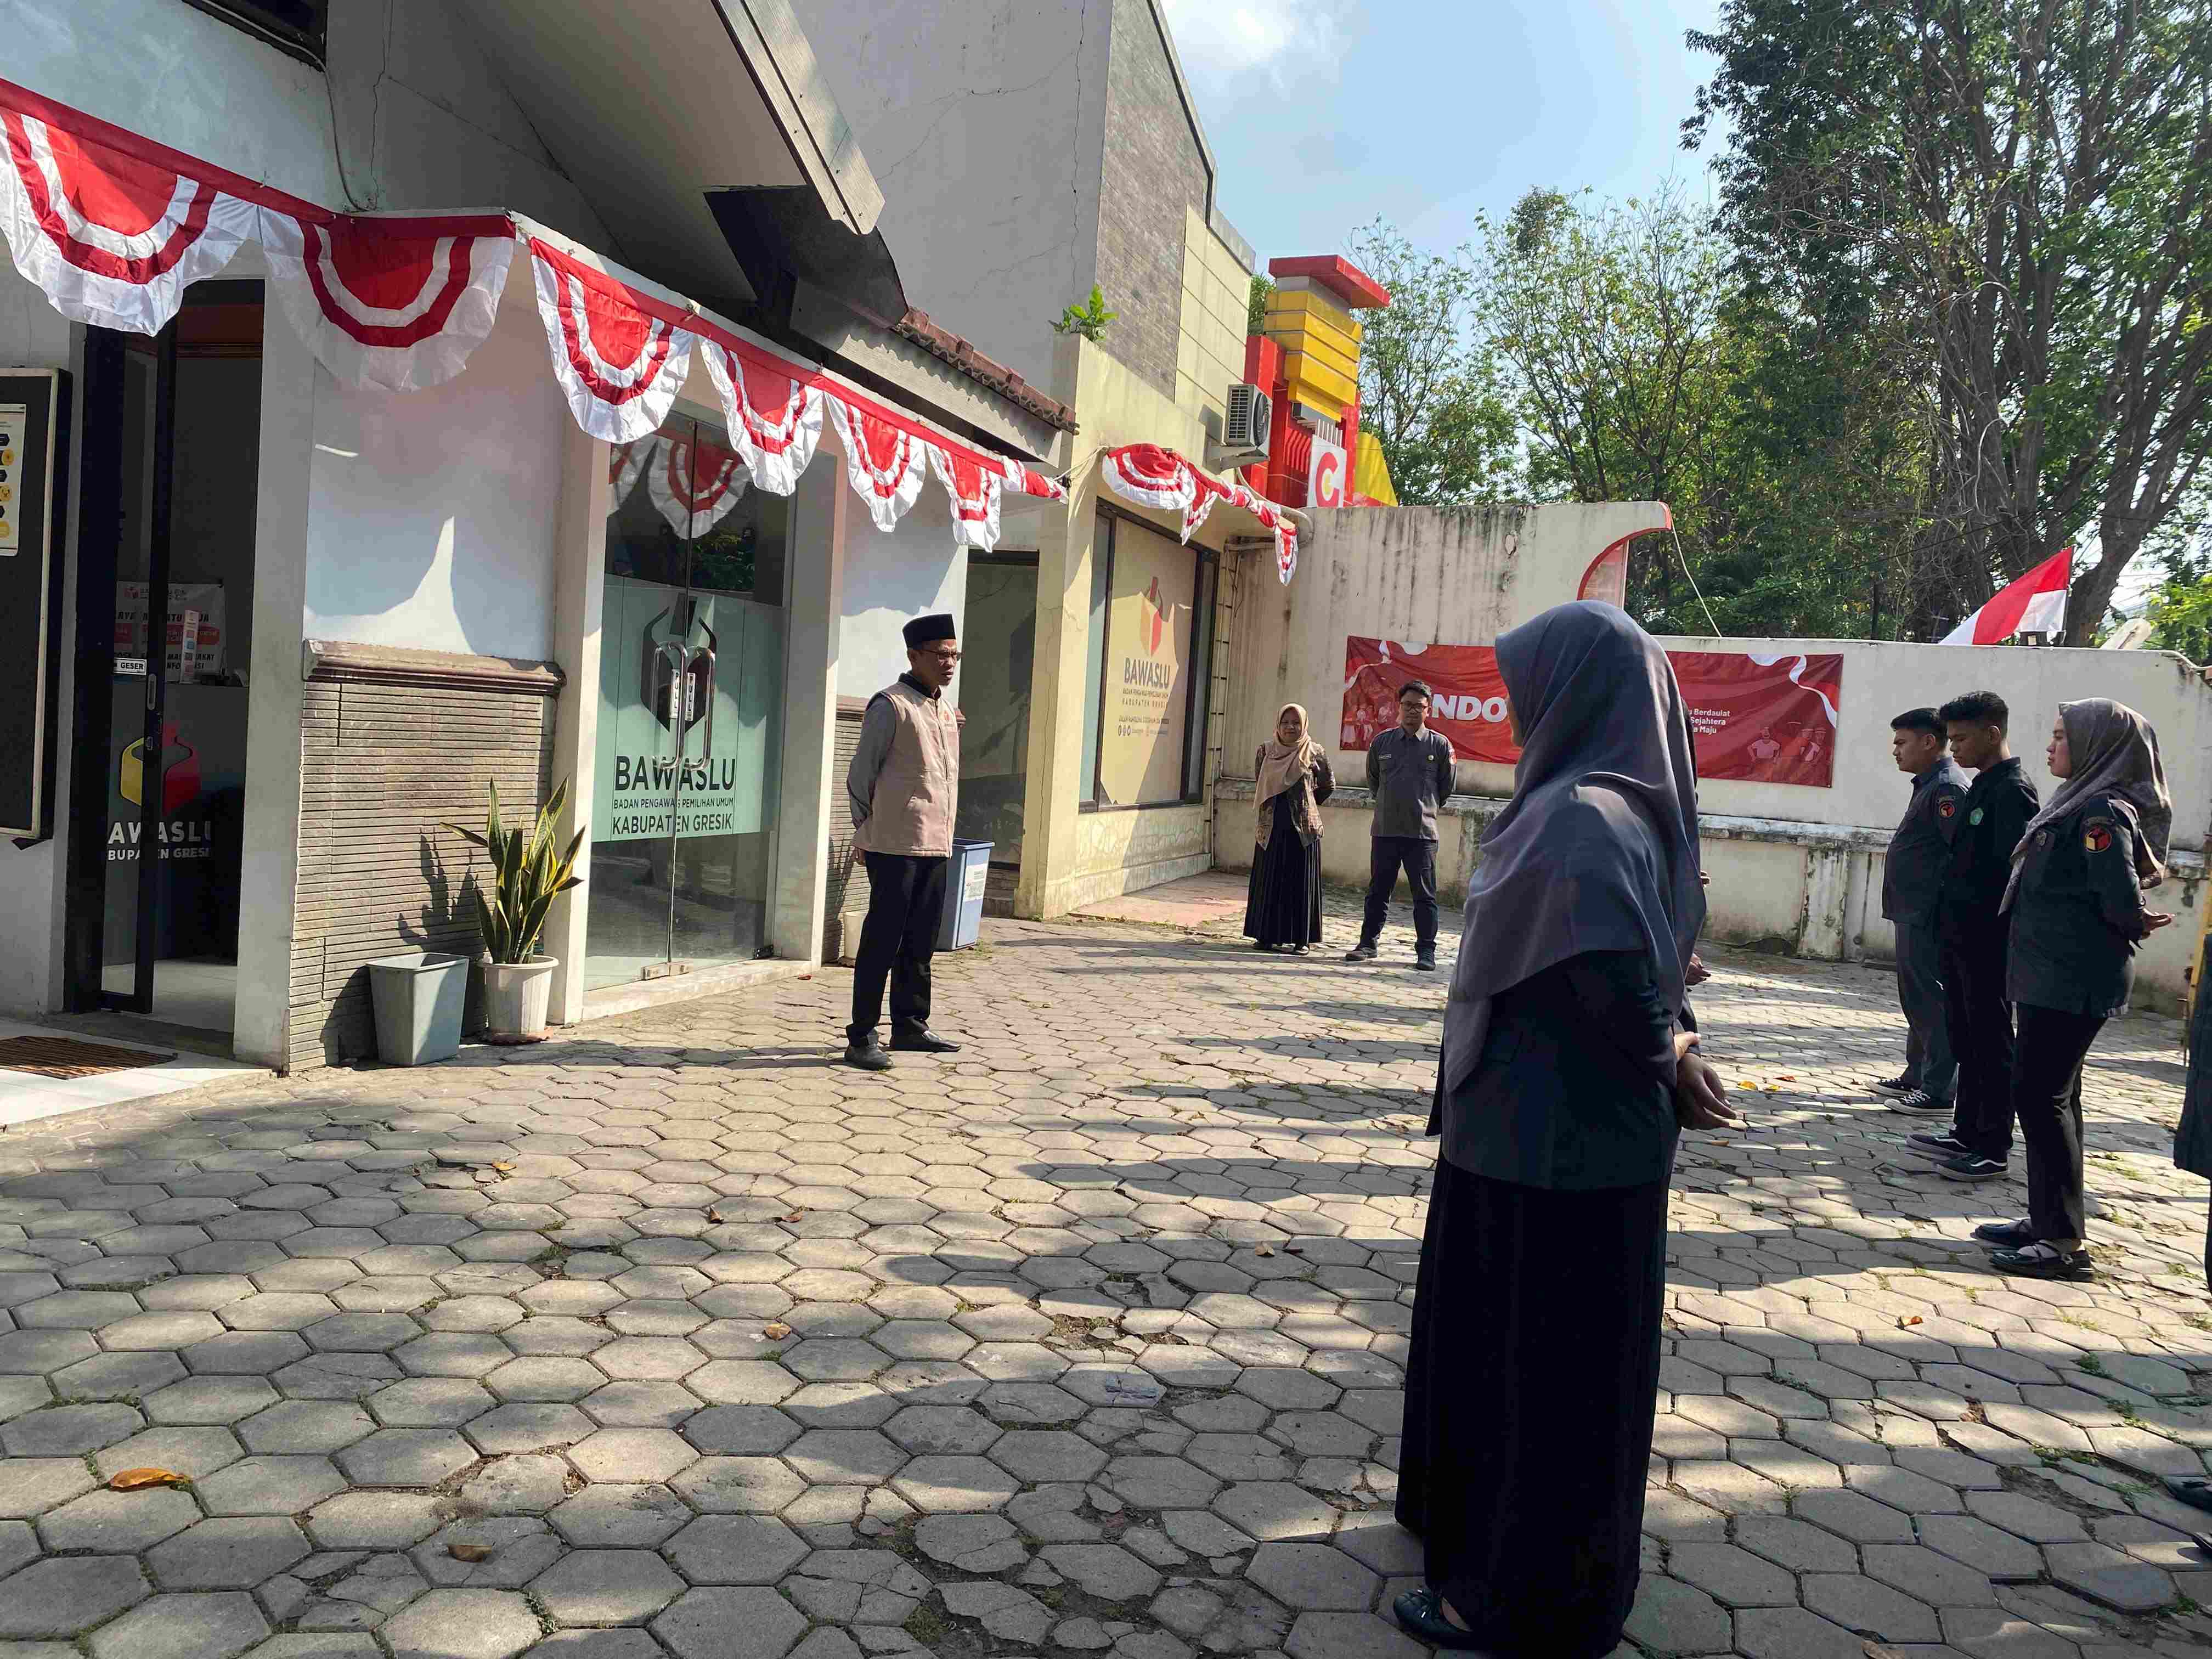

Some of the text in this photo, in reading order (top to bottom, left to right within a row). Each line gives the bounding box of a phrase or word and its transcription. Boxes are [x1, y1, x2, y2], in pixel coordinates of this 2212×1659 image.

[1125, 657, 1170, 689] BAWASLU
[1694, 708, 1730, 717] Berdaulat
[1690, 716, 1726, 725] Sejahtera
[1700, 726, 1717, 735] Maju
[614, 755, 736, 791] BAWASLU
[614, 797, 733, 809] BADAN PENGAWAS PEMILIHAN UMUM
[612, 813, 732, 834] KABUPATEN GRESIK
